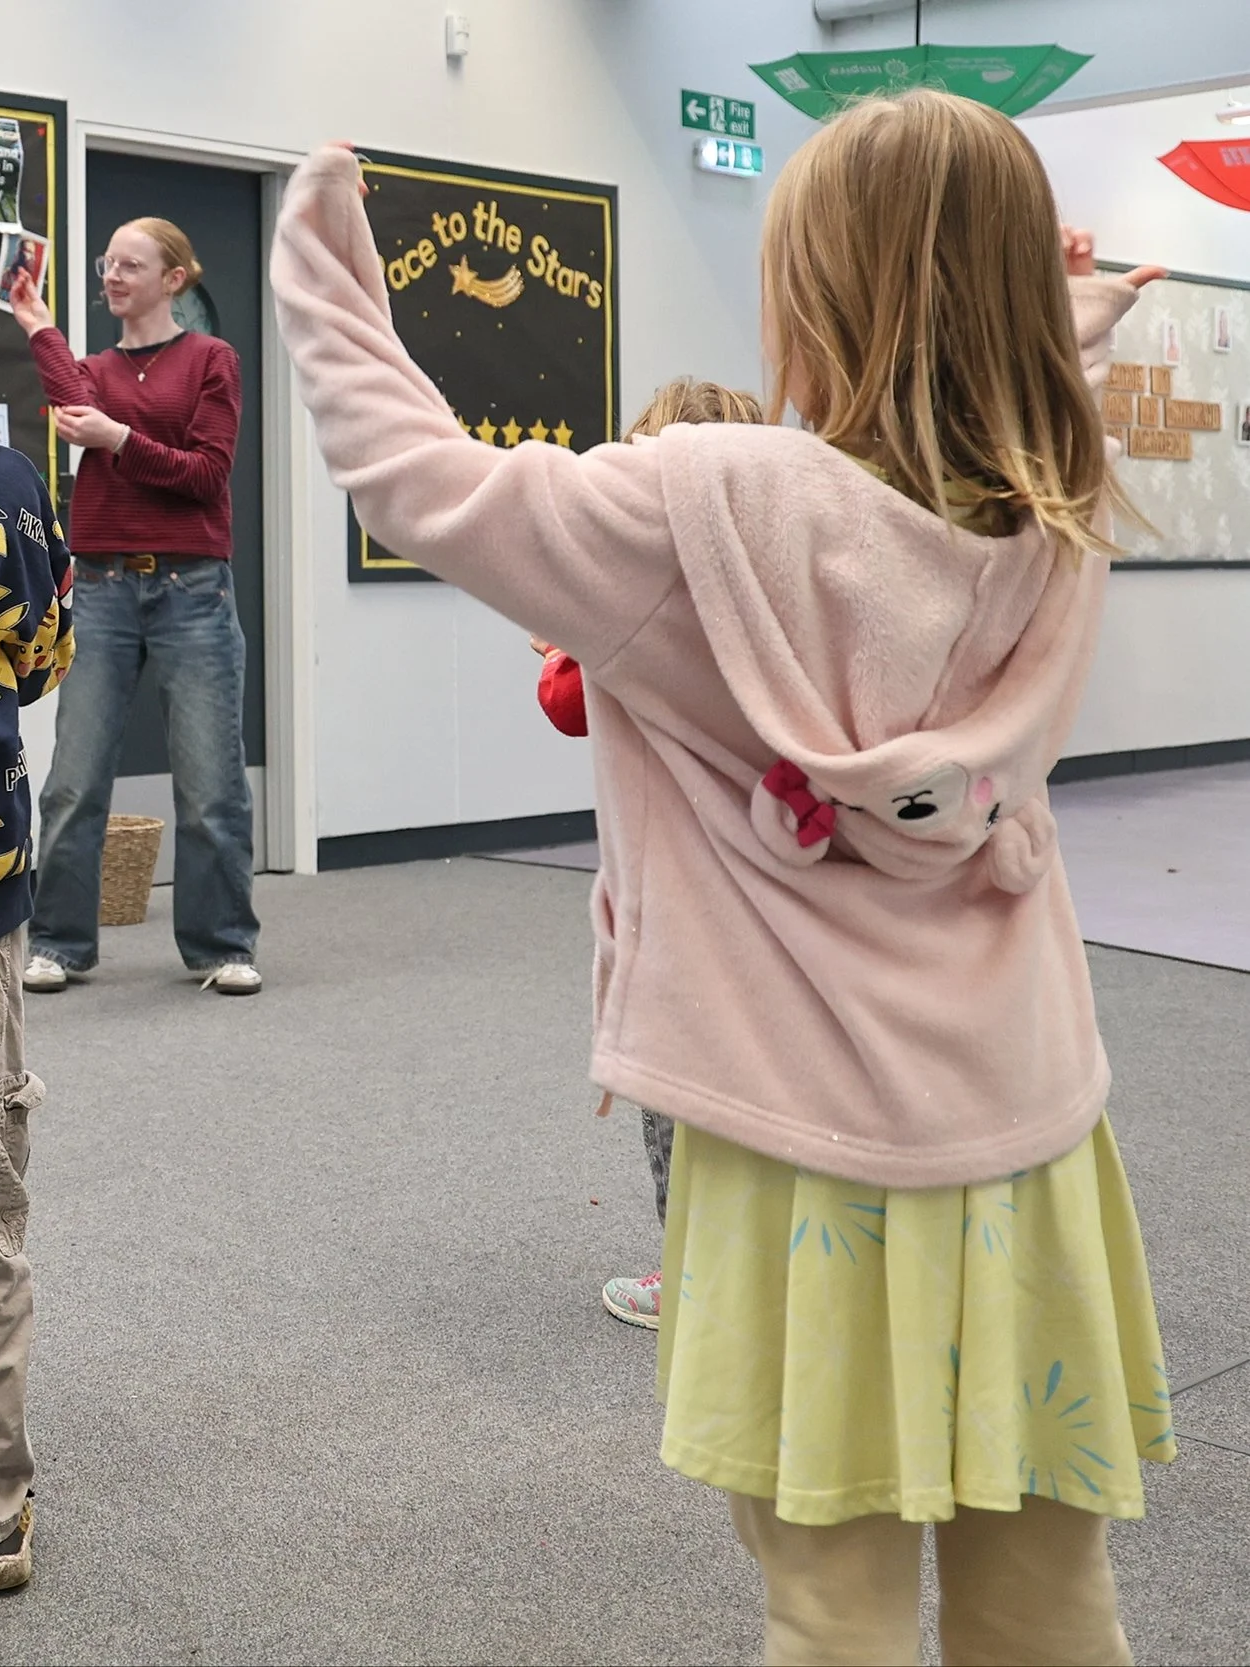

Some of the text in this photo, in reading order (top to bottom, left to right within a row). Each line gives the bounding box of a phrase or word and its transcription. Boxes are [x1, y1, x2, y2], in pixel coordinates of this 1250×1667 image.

[730, 101, 751, 120] Fire
[730, 120, 750, 136] exit
[2, 160, 14, 172] in
[379, 200, 603, 308] ace to the Stars
[17, 508, 49, 551] PIKA
